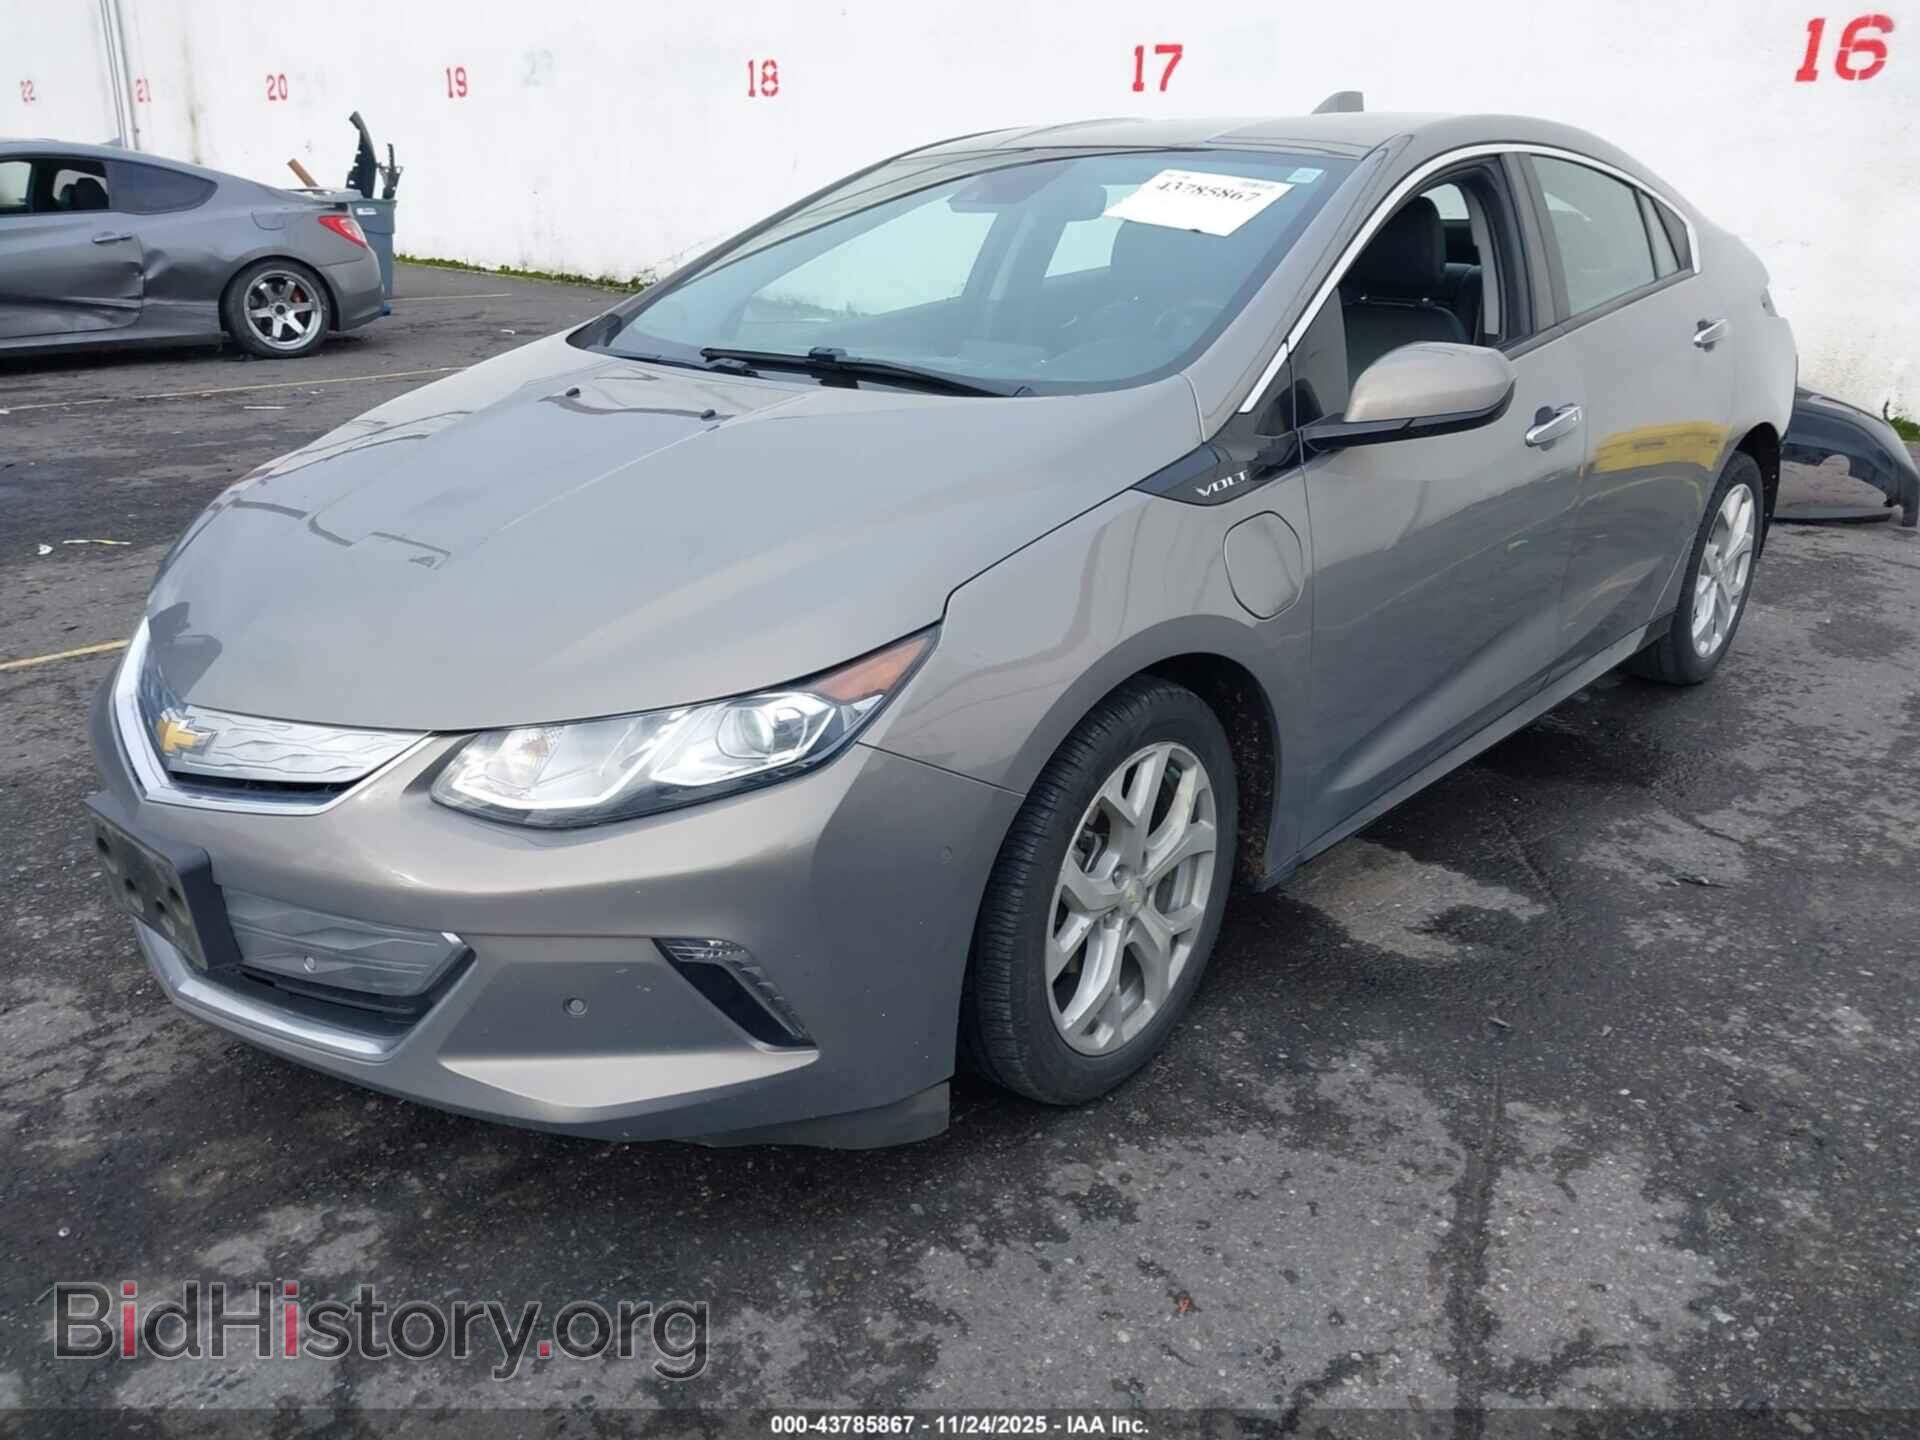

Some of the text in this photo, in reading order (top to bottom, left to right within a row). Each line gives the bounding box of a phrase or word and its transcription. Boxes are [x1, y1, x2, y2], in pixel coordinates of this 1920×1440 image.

[1795, 14, 1895, 82] 16
[446, 67, 468, 98] 19
[747, 59, 779, 97] 18
[1132, 44, 1183, 92] 17
[20, 79, 36, 102] 22
[136, 78, 151, 102] 21
[266, 74, 288, 100] 20
[1194, 469, 1249, 497] VOLT
